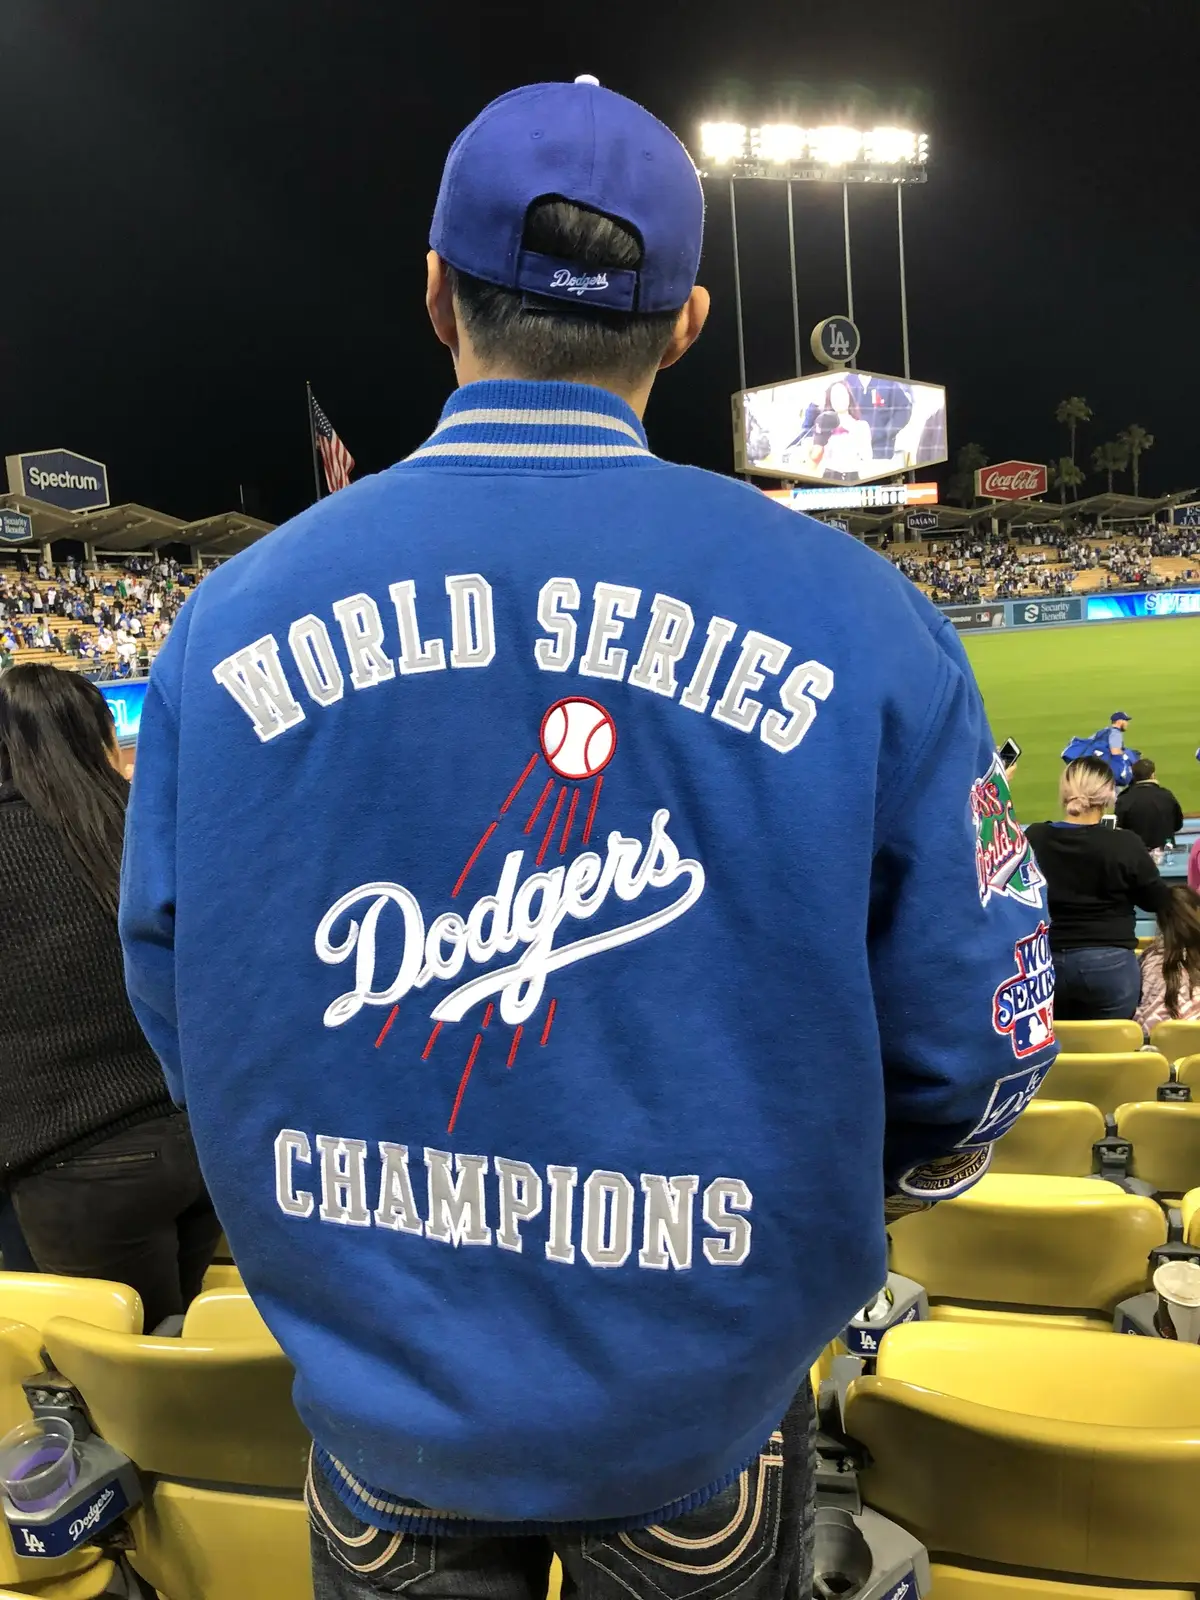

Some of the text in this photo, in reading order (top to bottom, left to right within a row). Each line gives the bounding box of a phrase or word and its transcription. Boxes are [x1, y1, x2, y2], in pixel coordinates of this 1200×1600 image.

[549, 268, 609, 296] Dodgers
[829, 323, 850, 355] LA
[28, 466, 98, 491] Spectrum
[909, 517, 937, 530] DASANI
[1040, 603, 1070, 614] Security
[1041, 611, 1067, 622] Benefit
[211, 573, 834, 754] WORLD SERIES
[314, 807, 706, 1028] Dodgers
[997, 966, 1055, 1028] SERIE
[914, 1178, 951, 1190] WORLD
[273, 1128, 753, 1271] CHAMPIONS
[859, 1330, 877, 1350] LA
[68, 1488, 115, 1541] Dodgers
[20, 1528, 46, 1553] LA
